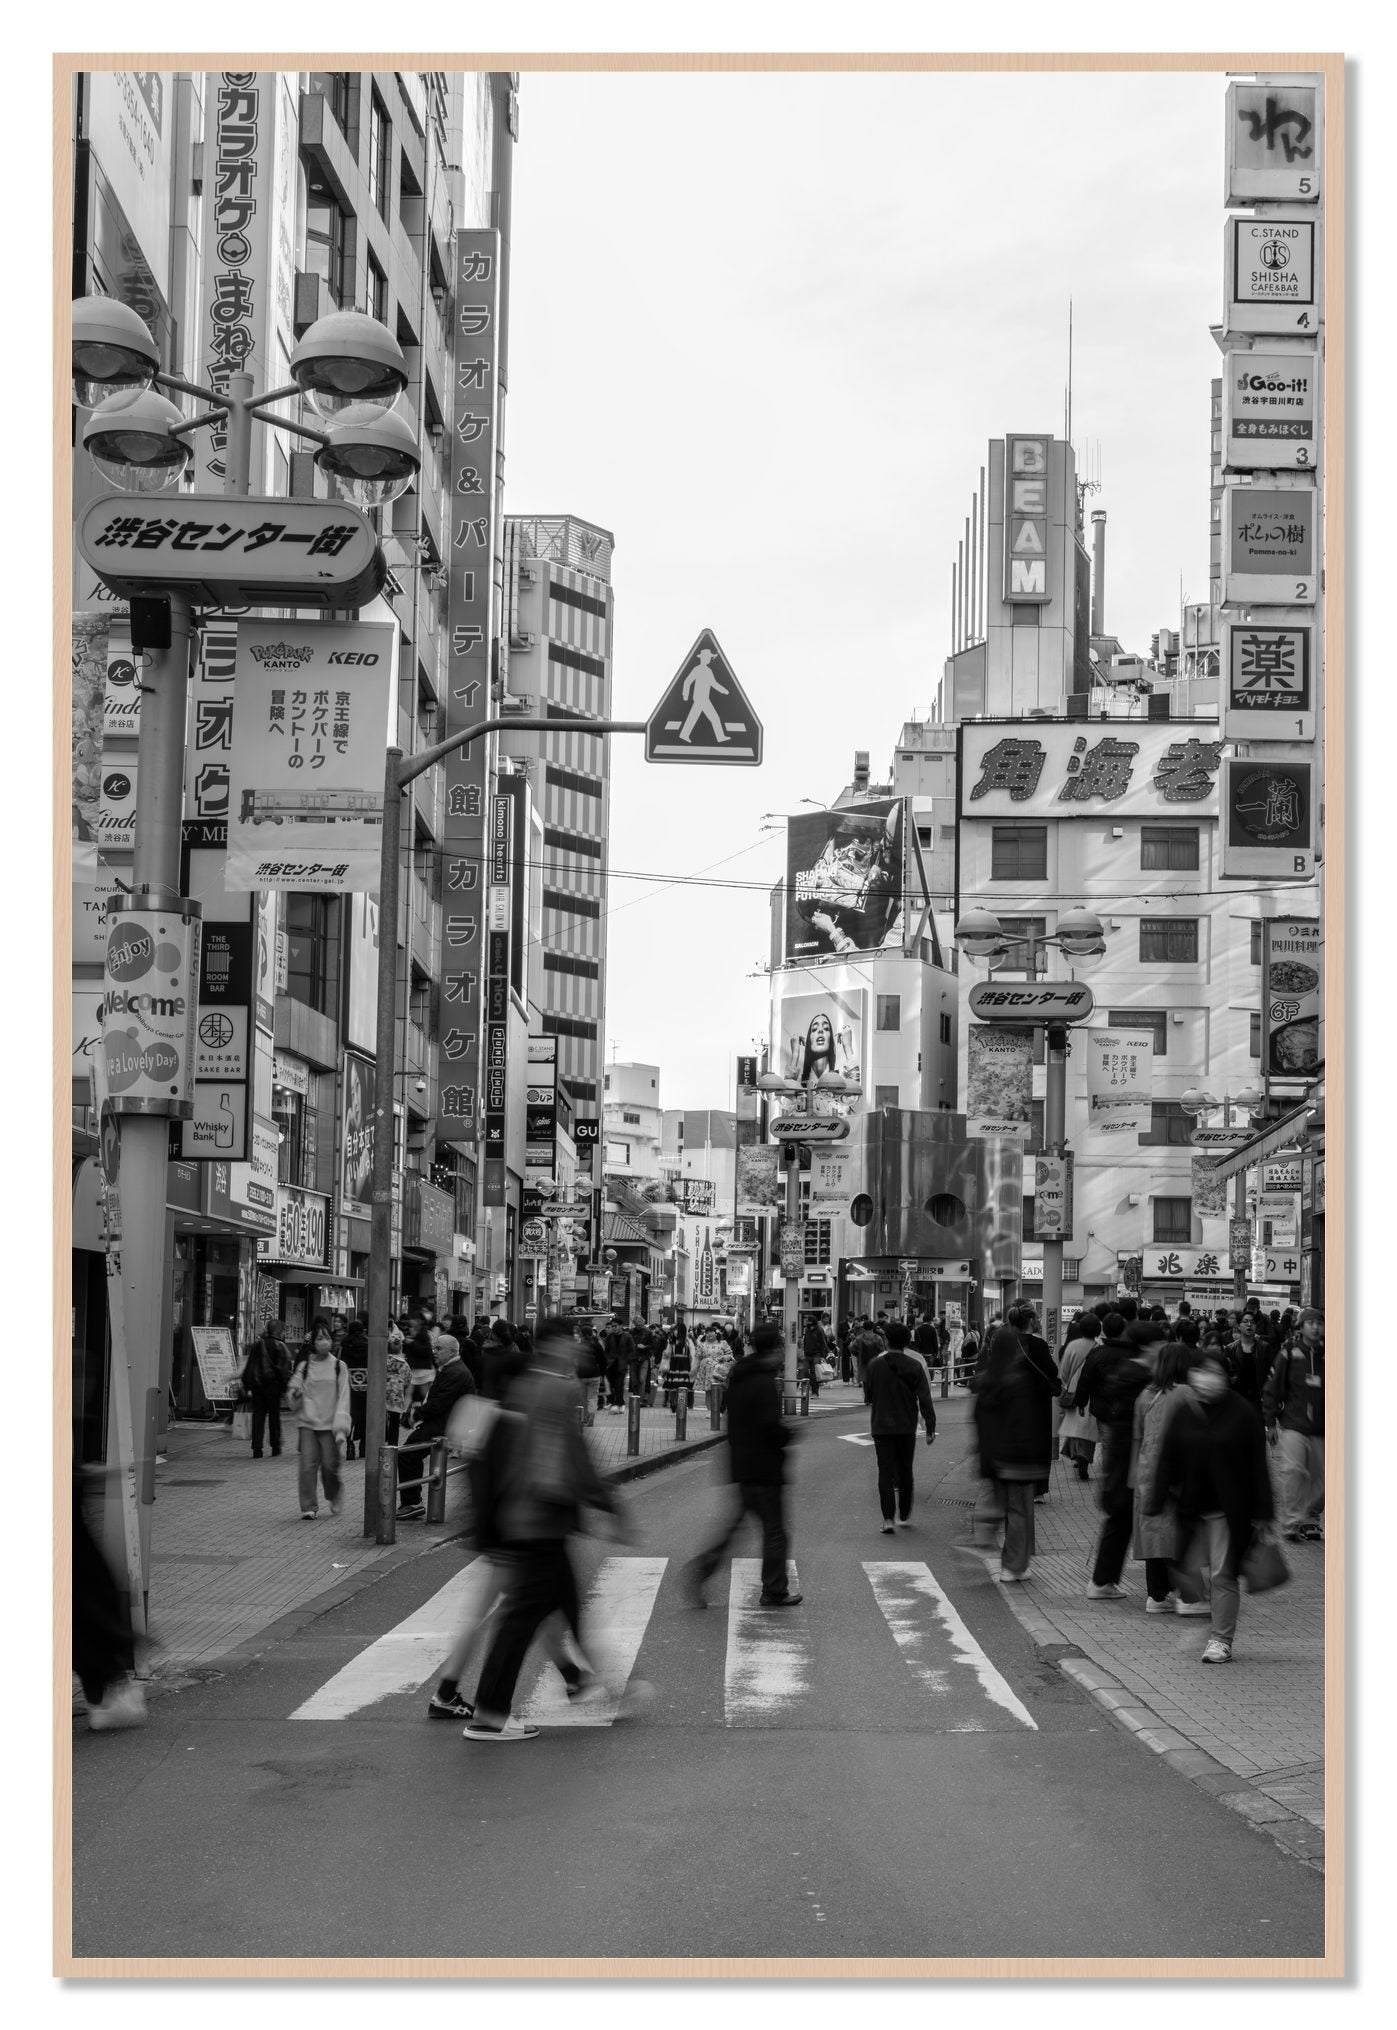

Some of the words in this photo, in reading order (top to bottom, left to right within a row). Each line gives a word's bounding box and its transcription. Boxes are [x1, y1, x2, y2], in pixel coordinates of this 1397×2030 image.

[214, 87, 260, 234] カラオケ
[1298, 177, 1312, 194] 5
[1251, 228, 1299, 239] C.STAND
[1251, 271, 1299, 283] SHISHA
[1251, 283, 1299, 292] CAFE&BAR
[1296, 312, 1310, 329] 4
[1249, 375, 1308, 393] Goo-it!
[1242, 396, 1304, 406] 渋谷宇田川町店
[1236, 423, 1309, 435] 全身もみほぐし
[1295, 447, 1309, 464] 3
[1012, 440, 1047, 594] BEAM
[94, 516, 360, 557] 渋谷センター街
[1295, 583, 1308, 599] 2
[327, 652, 379, 666] KEIO
[1241, 634, 1295, 688] 薬
[1234, 691, 1300, 707] マツモトキヨシ
[269, 690, 286, 736] 冒険へ
[108, 719, 135, 729] 渋谷店
[288, 690, 307, 769] カントーの
[310, 690, 329, 769] ポケパーク
[332, 690, 351, 754] 京王線で
[1294, 719, 1304, 736] 1
[969, 736, 1225, 801] 角海老
[1235, 778, 1300, 830] 一蘭
[495, 800, 504, 838] kimono
[104, 832, 131, 843] 渋谷店
[254, 862, 350, 877] 渋谷センター街
[495, 843, 504, 880] hearts
[1294, 856, 1306, 872] B
[495, 888, 504, 902] HAIR
[495, 904, 504, 922] SALON
[207, 943, 230, 951] THIRD
[1271, 940, 1319, 953] 四川料理
[108, 937, 152, 974] Enjoy
[206, 973, 229, 981] ROOM
[210, 984, 225, 993] BAR
[441, 859, 479, 1118] カラオケ館
[104, 989, 186, 1018] Welcome
[976, 992, 1086, 1006] 渋谷センター街
[1270, 1001, 1300, 1022] 6F
[135, 1012, 155, 1033] Shibuya
[123, 1052, 155, 1073] Lovely
[156, 1053, 178, 1069] Day!
[193, 1121, 229, 1134] Whisky
[576, 1126, 598, 1137] GU
[774, 1122, 841, 1132] 渋谷センター街
[193, 1132, 214, 1141] Bank
[1157, 1251, 1221, 1275] 兆楽
[702, 1251, 712, 1295] BEER
